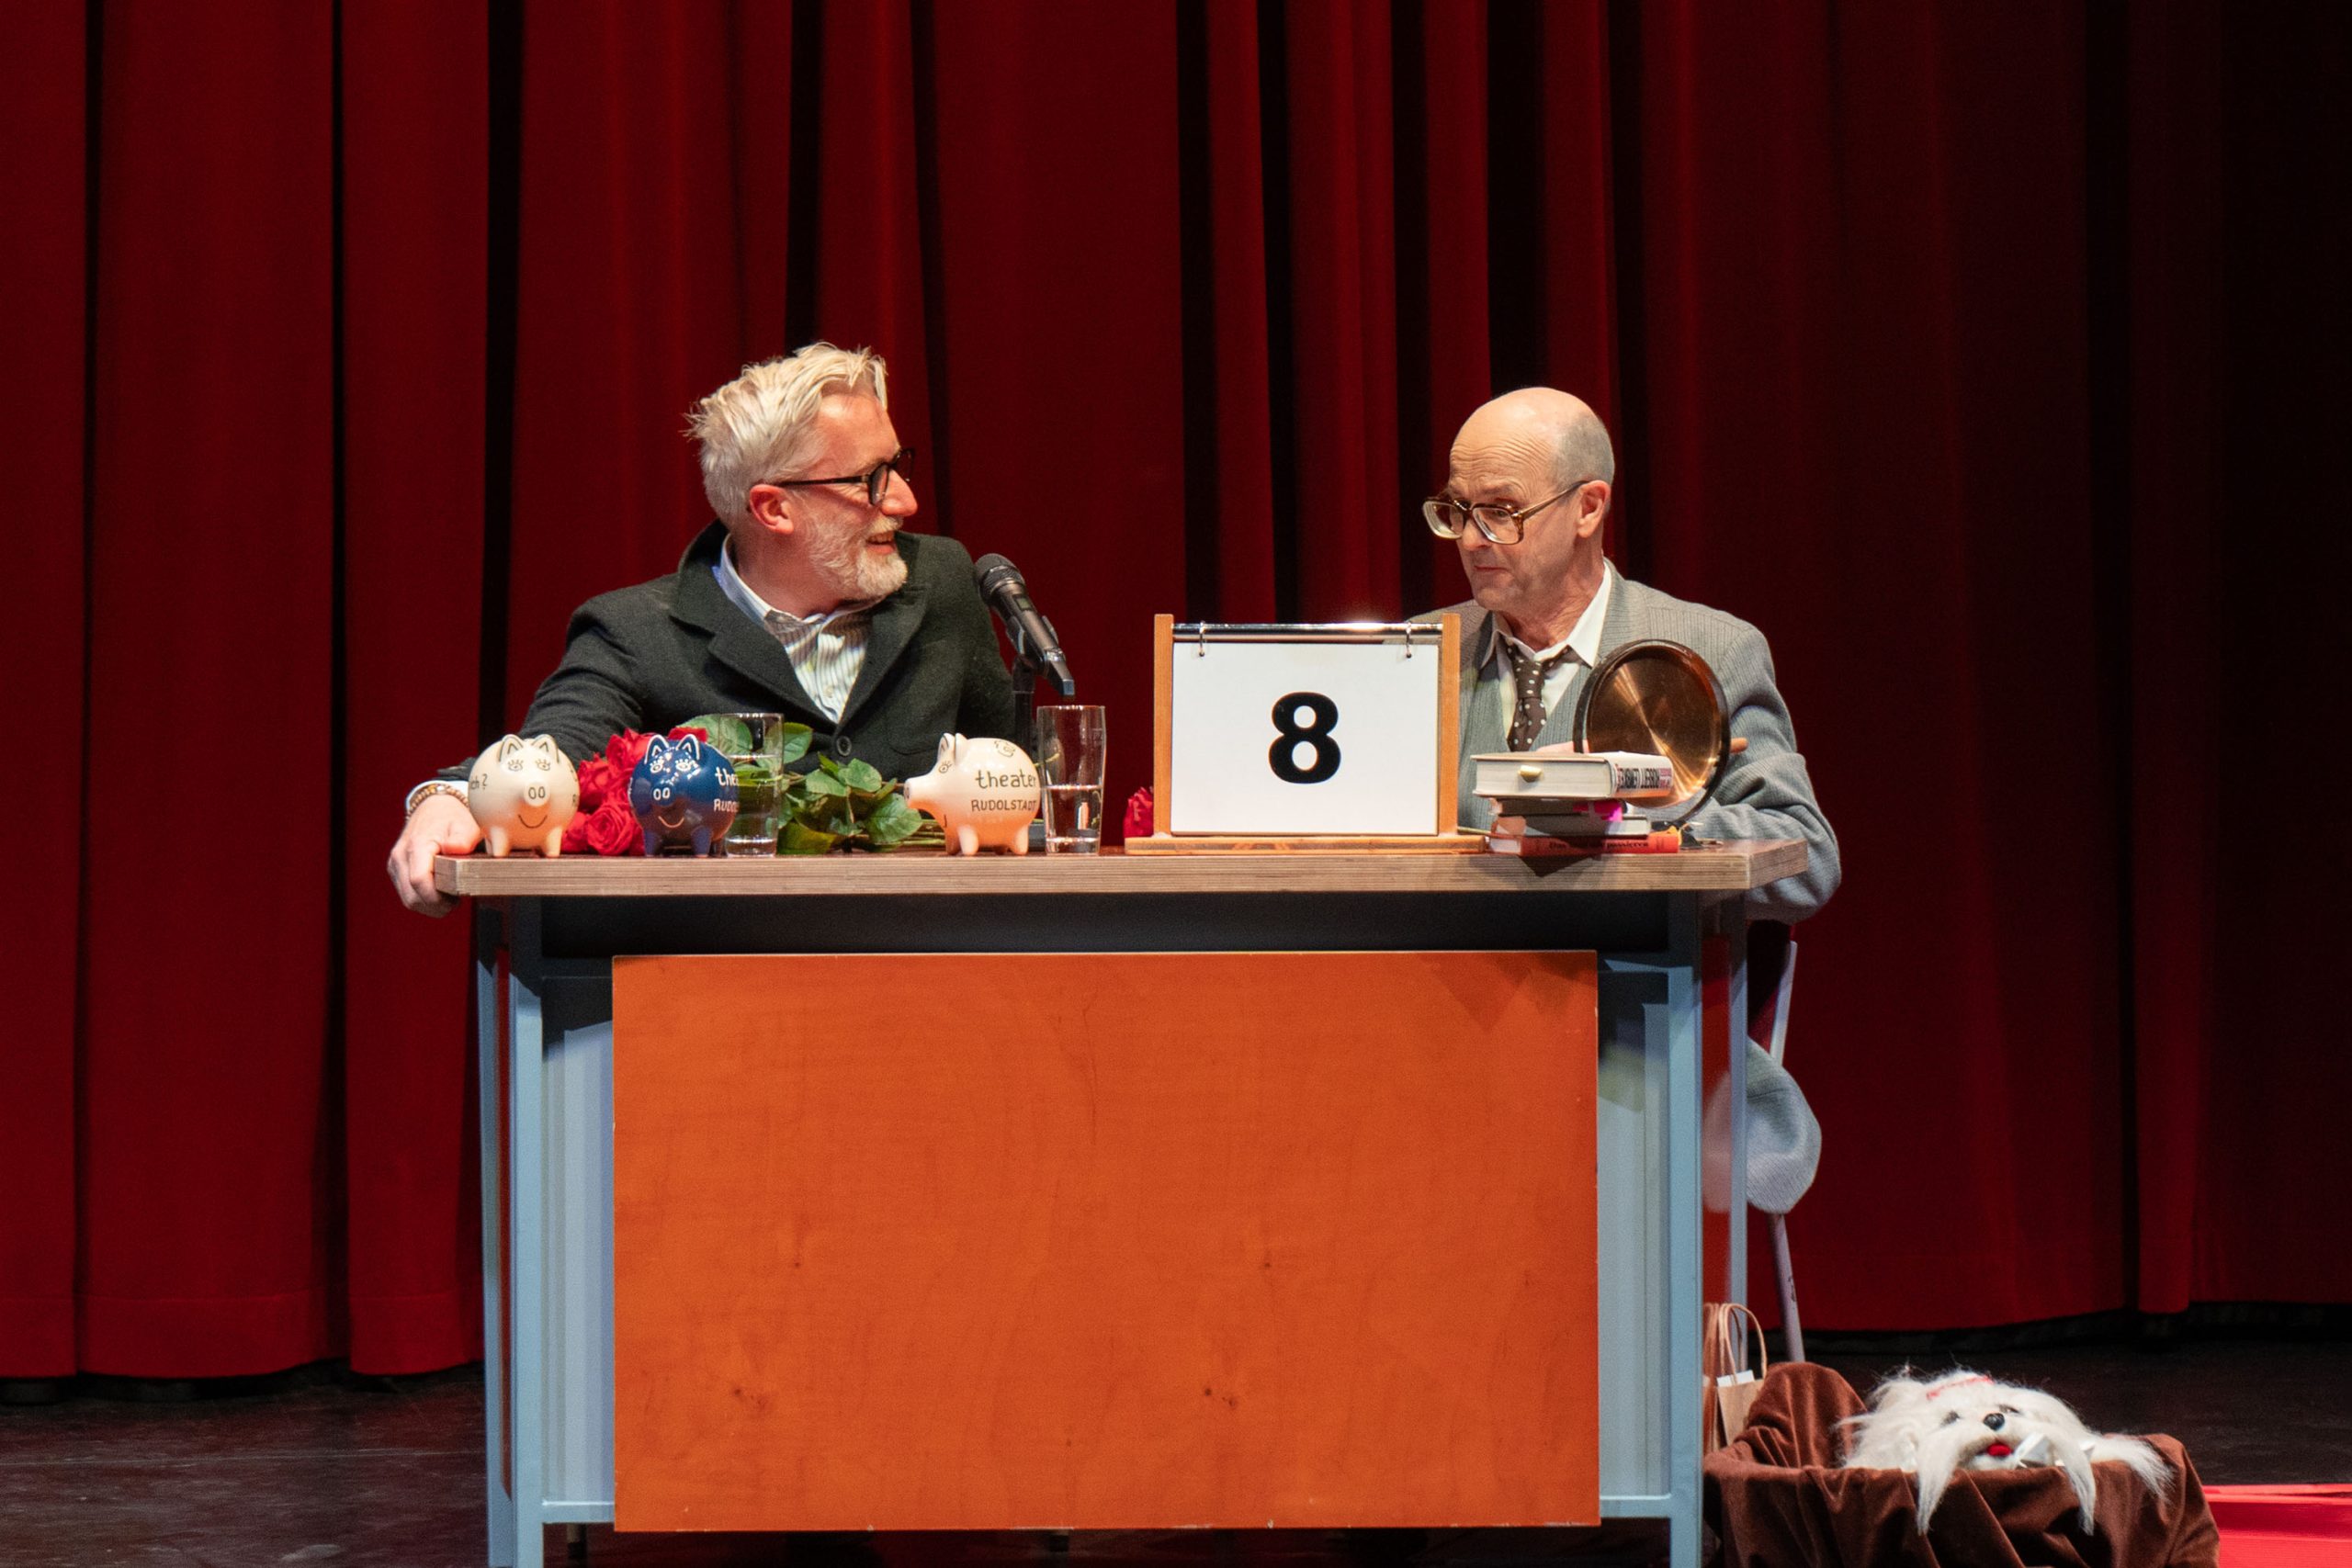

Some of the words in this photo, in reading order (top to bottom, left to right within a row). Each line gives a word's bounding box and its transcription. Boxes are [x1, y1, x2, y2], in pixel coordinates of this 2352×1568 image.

[1268, 691, 1341, 784] 8
[975, 769, 1036, 789] theater
[970, 798, 1037, 813] RUDOLSTADT
